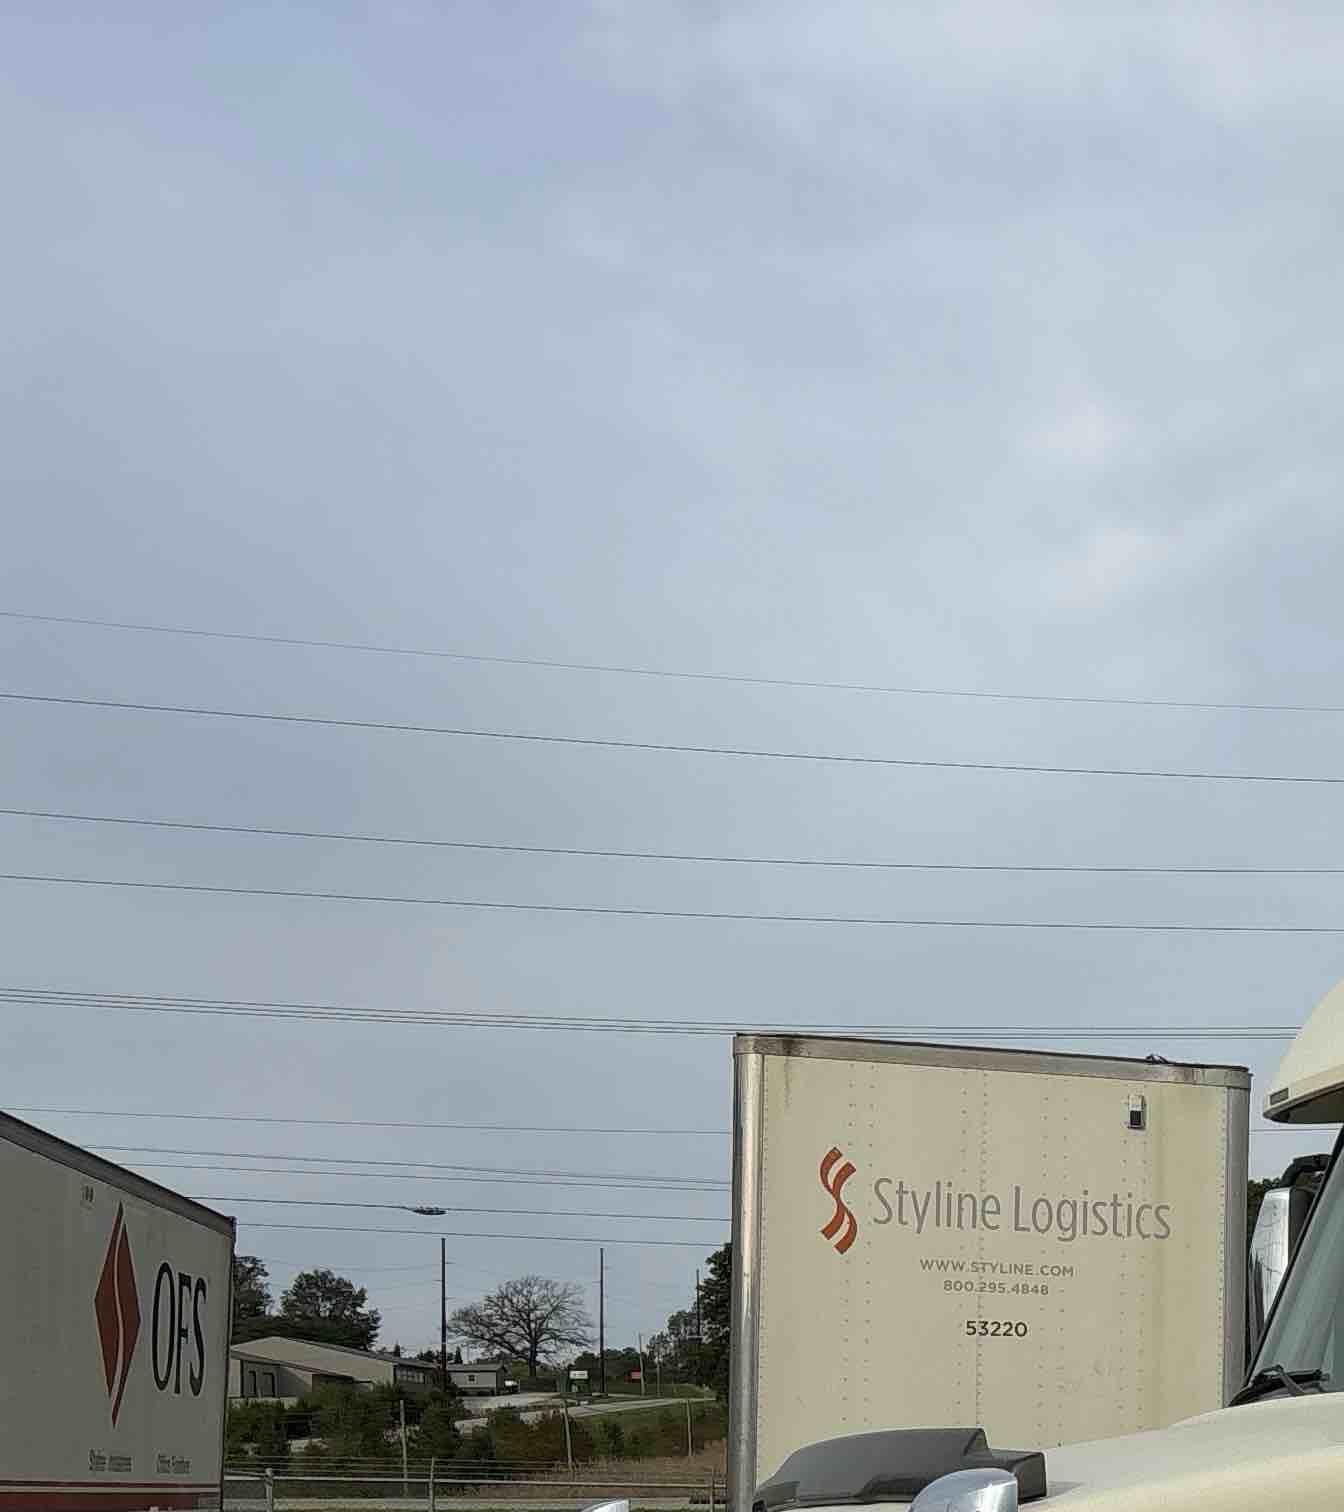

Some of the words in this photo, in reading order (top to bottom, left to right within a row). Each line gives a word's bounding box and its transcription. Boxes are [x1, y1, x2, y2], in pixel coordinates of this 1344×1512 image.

[872, 1176, 1001, 1233] Styline
[1013, 1184, 1171, 1242] Logistics
[919, 1258, 1074, 1277] WWW.STYLINE.COM
[943, 1279, 1049, 1296] 800.295.4848
[152, 1262, 206, 1397] OFS
[965, 1320, 1028, 1338] 53220
